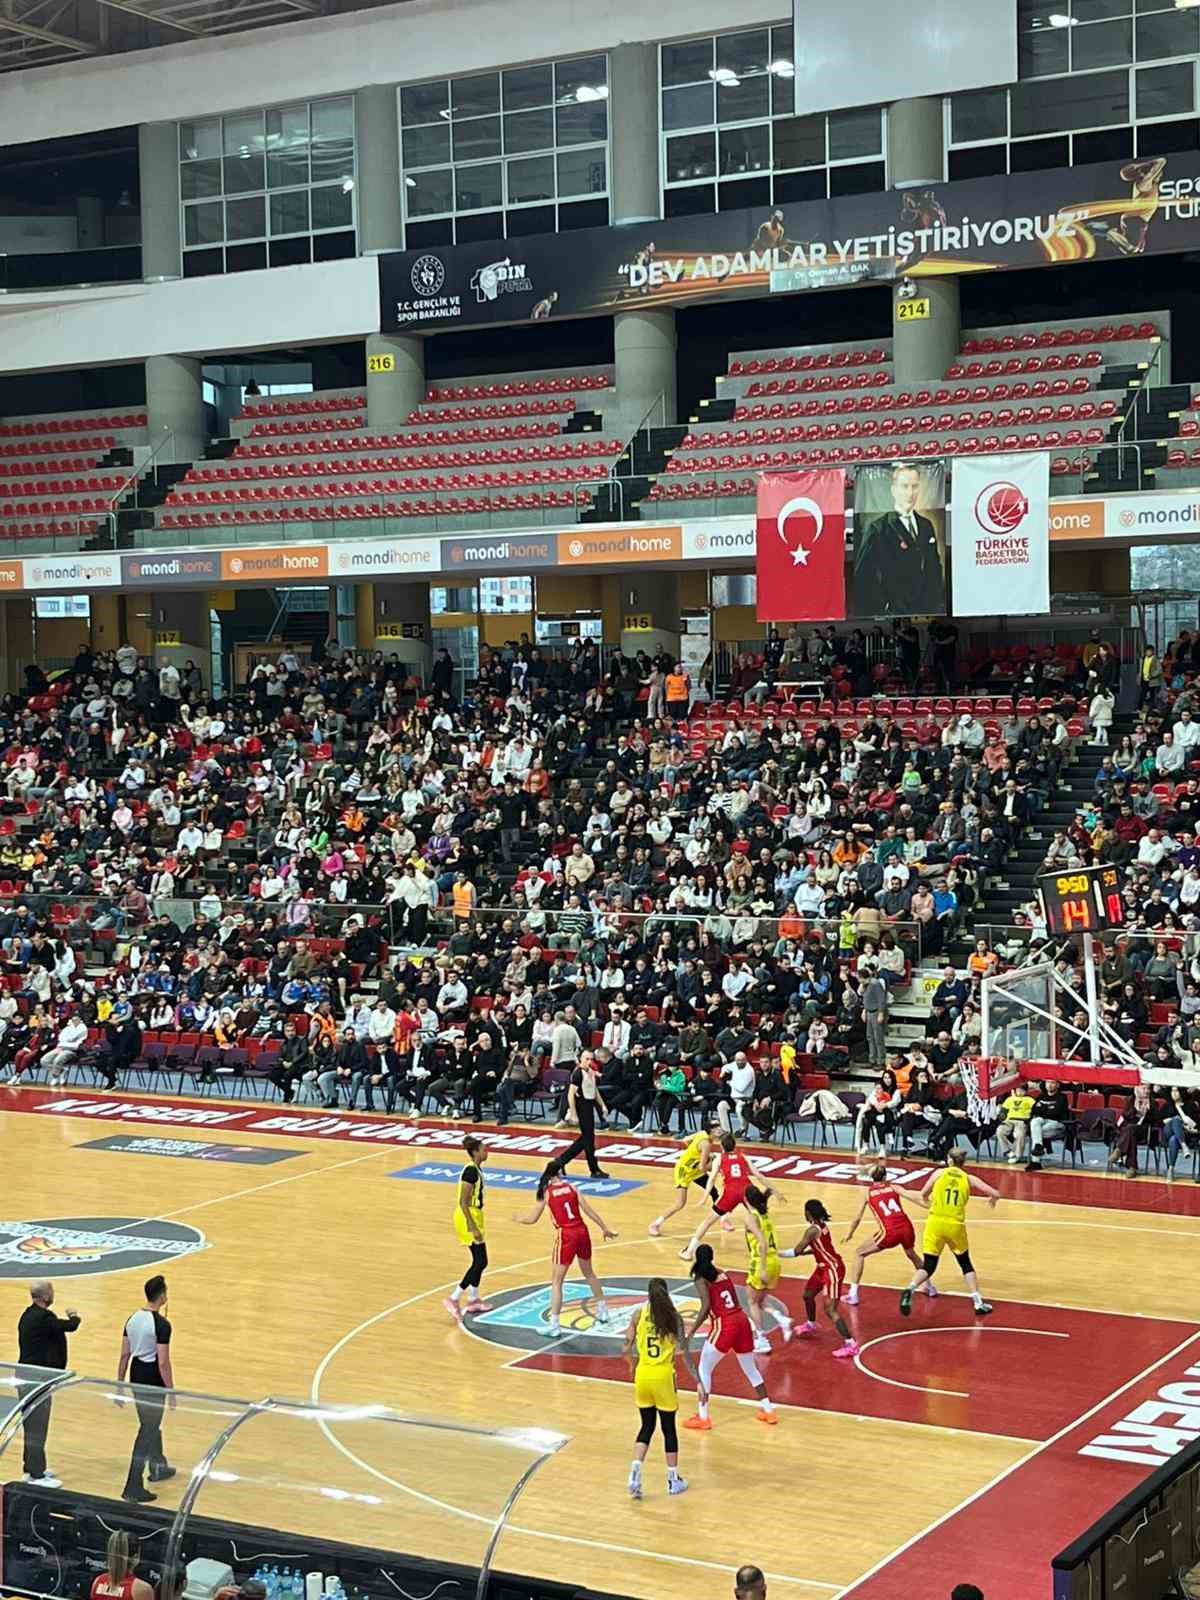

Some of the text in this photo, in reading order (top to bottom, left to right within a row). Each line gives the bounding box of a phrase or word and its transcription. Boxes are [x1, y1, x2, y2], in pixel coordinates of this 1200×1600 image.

[691, 242, 828, 280] ADAMLAR
[397, 296, 460, 311] T.C. GENÇLİK VE
[899, 303, 925, 318] 214
[397, 307, 461, 322] SPOR BAKANLIĞI
[369, 357, 391, 370] 216
[583, 536, 672, 553] mondihome
[976, 536, 1029, 550] TÜRKİYE
[352, 549, 431, 566] mondihome
[464, 543, 548, 561] mondihome
[976, 549, 1029, 559] BASKETBOL
[140, 559, 214, 577] mondihome
[243, 554, 320, 571] mondihome
[976, 557, 1030, 566] FEDERASYONU
[43, 564, 112, 580] mondihome
[1063, 899, 1089, 931] 14
[564, 1201, 576, 1219] 1
[878, 1198, 901, 1217] 14
[720, 1290, 735, 1309] 3
[647, 1336, 660, 1358] 5
